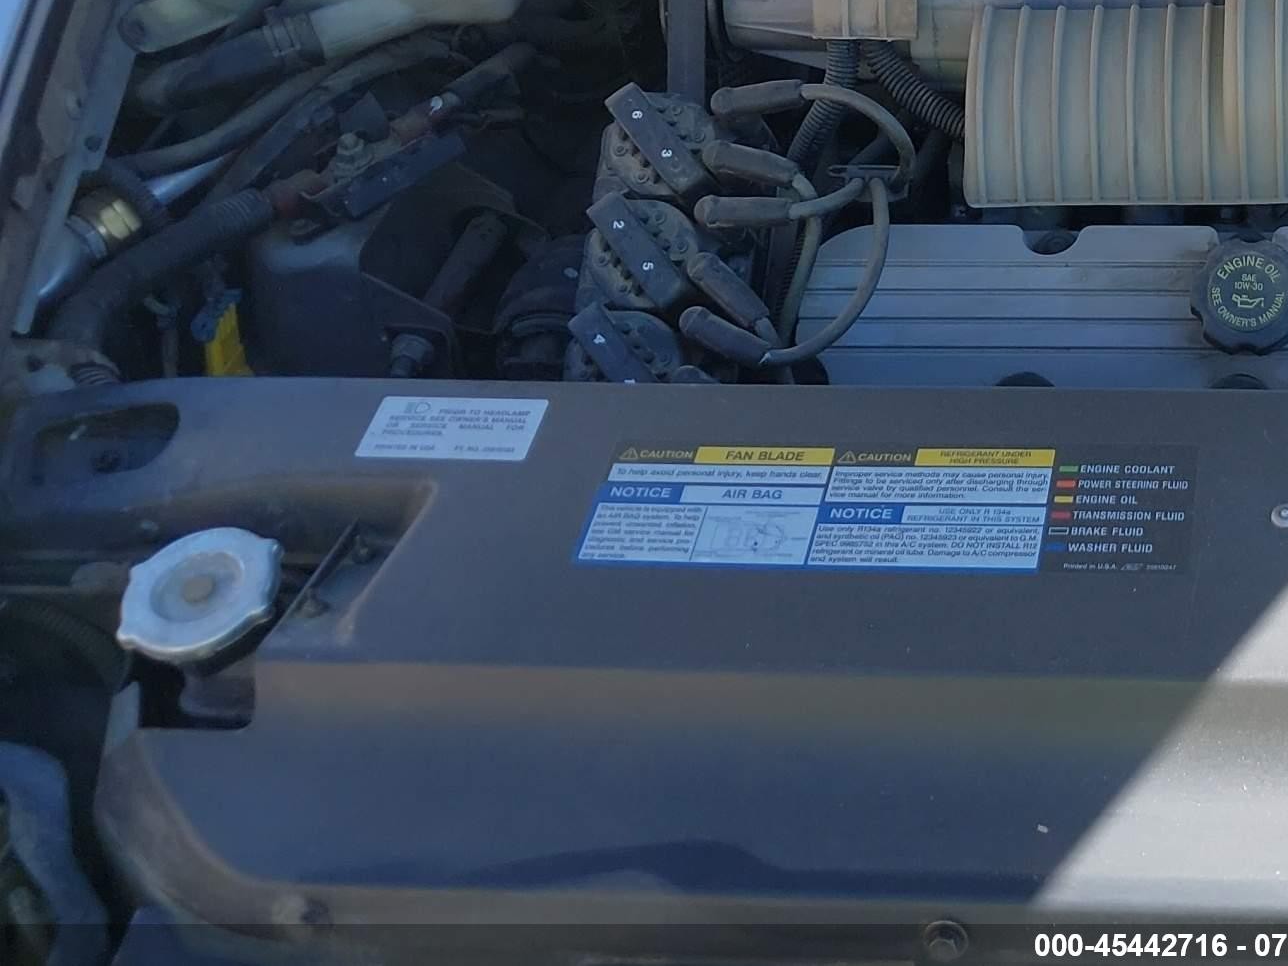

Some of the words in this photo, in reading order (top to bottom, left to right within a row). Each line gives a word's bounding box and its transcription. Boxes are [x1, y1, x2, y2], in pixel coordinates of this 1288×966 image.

[631, 109, 644, 120] 6
[660, 148, 674, 159] 3
[612, 219, 626, 231] 2
[642, 261, 655, 272] 5
[1216, 255, 1265, 280] ENGINE
[1264, 263, 1281, 283] OIL
[1241, 273, 1257, 282] SAE
[1210, 286, 1222, 307] SEE
[1217, 305, 1257, 328] OWNER'S
[1258, 291, 1285, 325] MANUAL
[592, 333, 606, 345] 4
[639, 450, 693, 459] CAUTION
[726, 450, 754, 460] FAN
[757, 450, 805, 461] BLADE
[857, 452, 911, 462] CAUTION
[940, 450, 1001, 458] REFRIGERANT
[628, 468, 648, 477] help
[650, 468, 675, 476] avoid
[676, 469, 715, 478] personal
[745, 470, 769, 479] keep
[1079, 464, 1121, 474] ENGINE
[1124, 465, 1176, 475] COOLANT
[942, 472, 961, 480] may
[987, 472, 1024, 480] personal
[966, 479, 1015, 487] discharging
[1077, 479, 1112, 489] POWER
[1114, 480, 1160, 490] STEERING
[1162, 480, 1190, 490] FLUID
[610, 486, 673, 498] NOTICE
[721, 489, 748, 499] AIR
[752, 489, 784, 499] BAG
[1075, 494, 1117, 504] ENGINE
[1119, 495, 1138, 504] OIL
[829, 508, 894, 519] NOTICE
[1072, 510, 1152, 521] TRANSMISSION
[1155, 511, 1186, 521] FLUID
[883, 526, 926, 534] refrigerant
[1070, 526, 1108, 536] BRAKE
[1111, 526, 1145, 536] FLUID
[832, 533, 869, 541] synthetic
[1067, 542, 1118, 552] WASHER
[1121, 543, 1153, 553] FLUID
[927, 550, 961, 558] Damage
